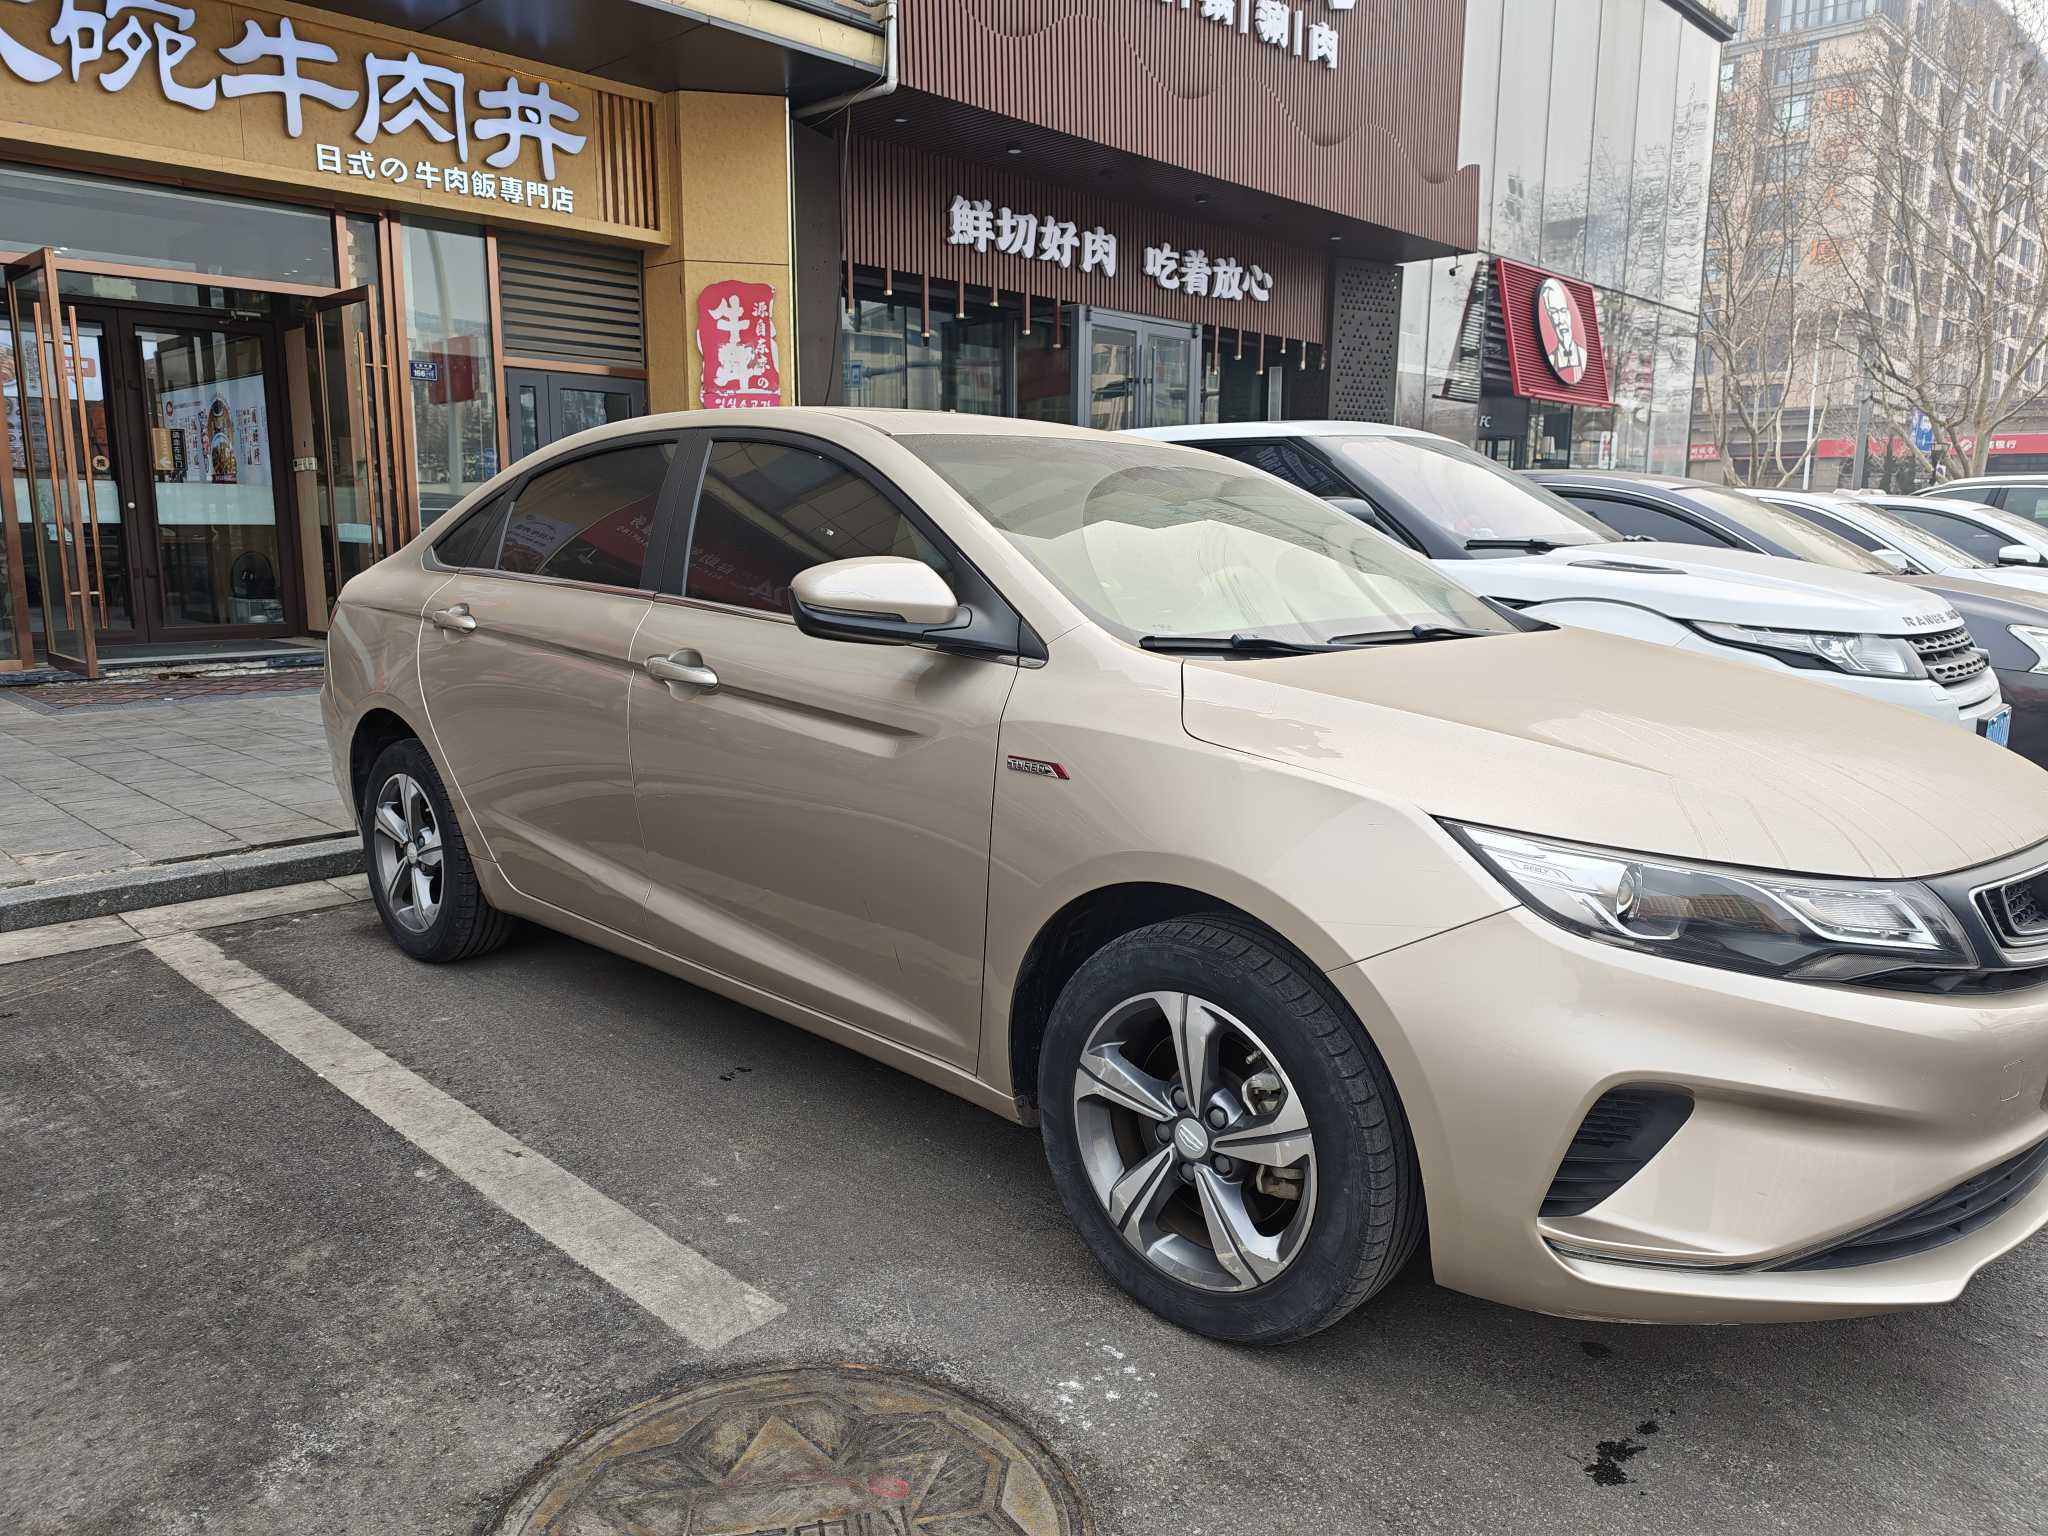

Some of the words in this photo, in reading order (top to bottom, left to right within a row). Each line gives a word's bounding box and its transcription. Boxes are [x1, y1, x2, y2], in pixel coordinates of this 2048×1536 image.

[315, 143, 575, 213] 日式の牛肉飯專門店
[1143, 242, 1273, 302] 吃着放心
[1479, 415, 1492, 428] FC
[1902, 613, 1947, 627] RANGE
